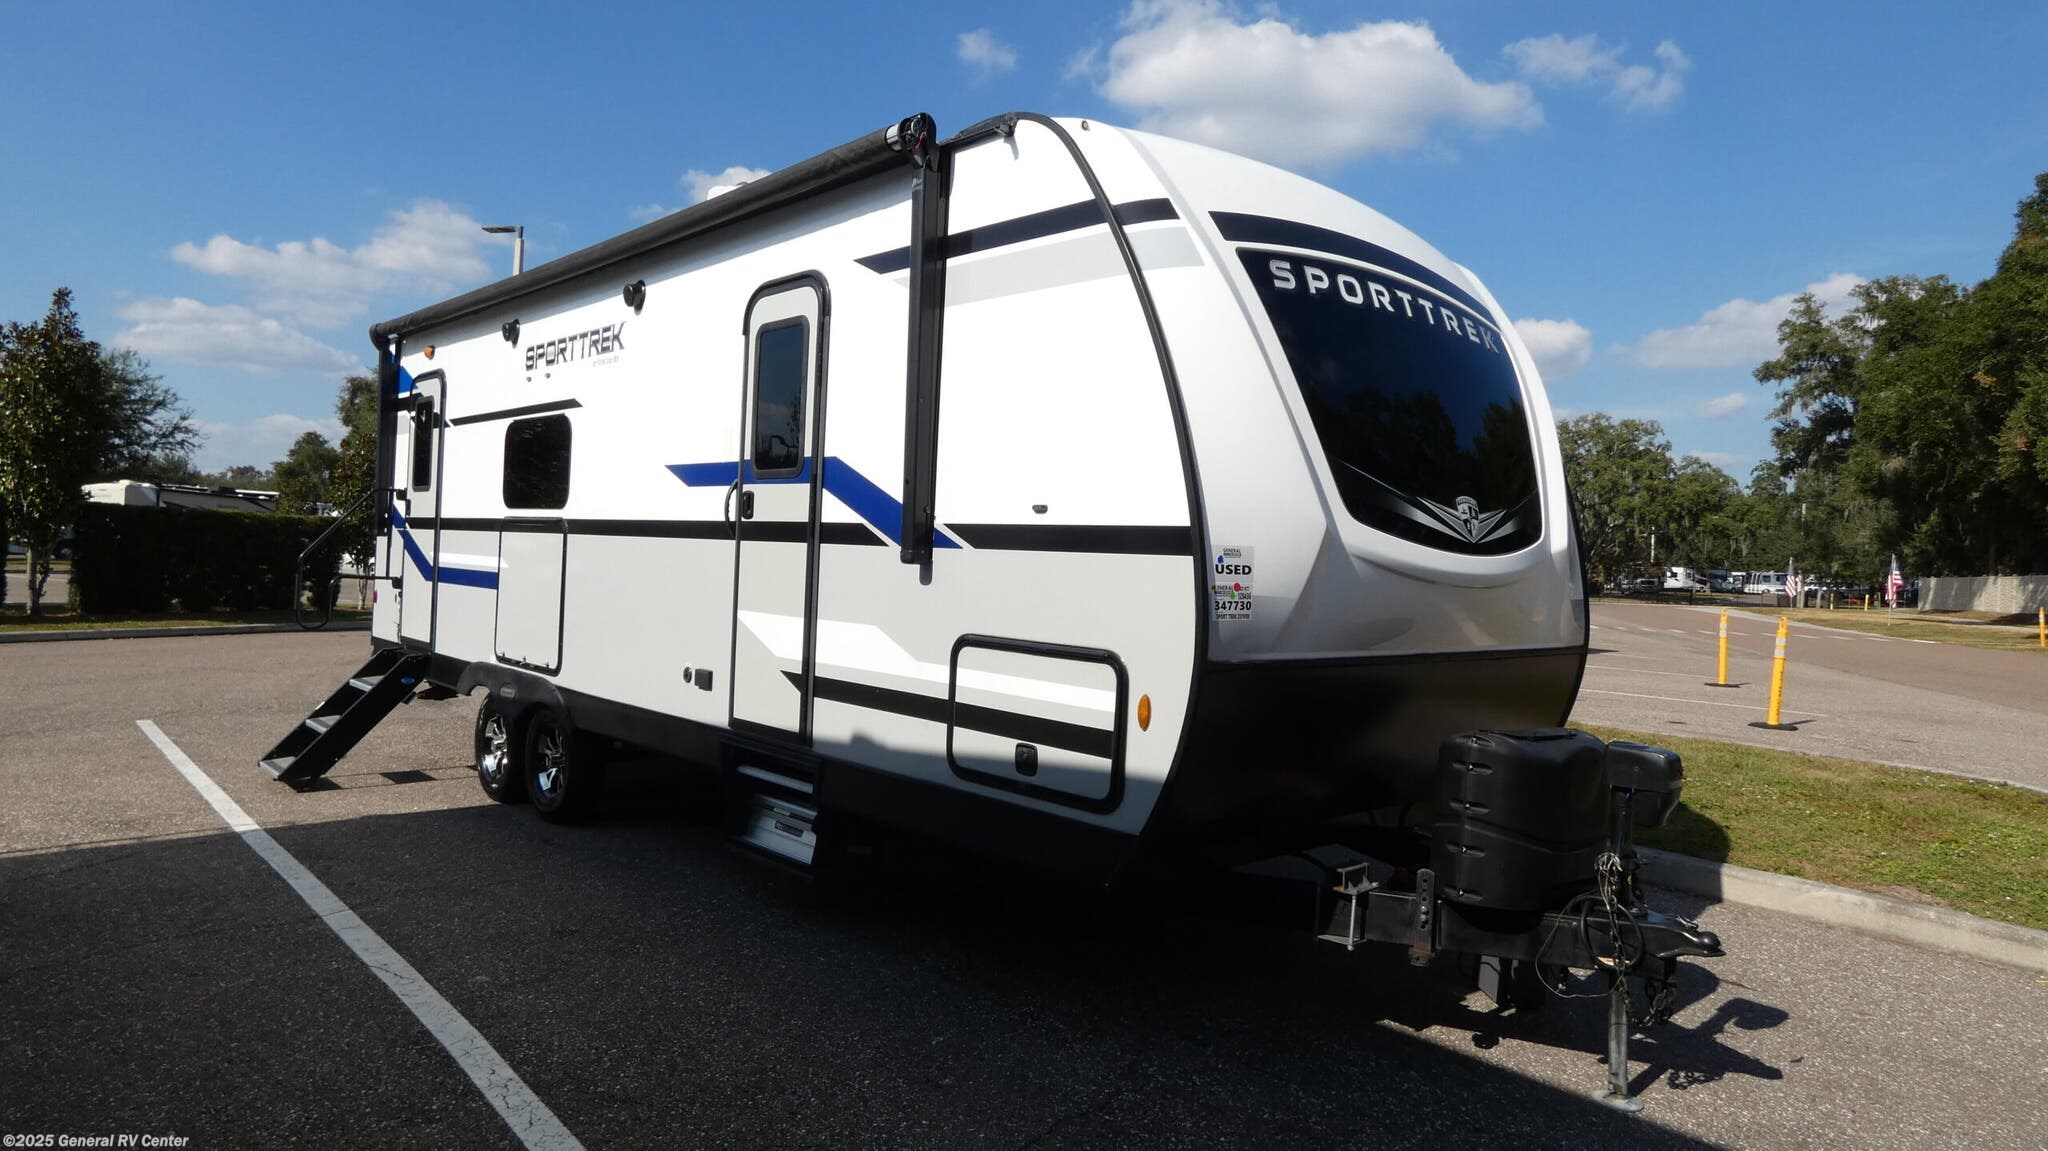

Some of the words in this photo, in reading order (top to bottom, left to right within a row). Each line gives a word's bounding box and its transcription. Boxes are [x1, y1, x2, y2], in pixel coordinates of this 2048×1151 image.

[1269, 259, 1499, 353] SPORTTREK
[526, 321, 627, 371] SPORTTREK
[1215, 564, 1252, 576] USED
[1214, 601, 1252, 611] 347730
